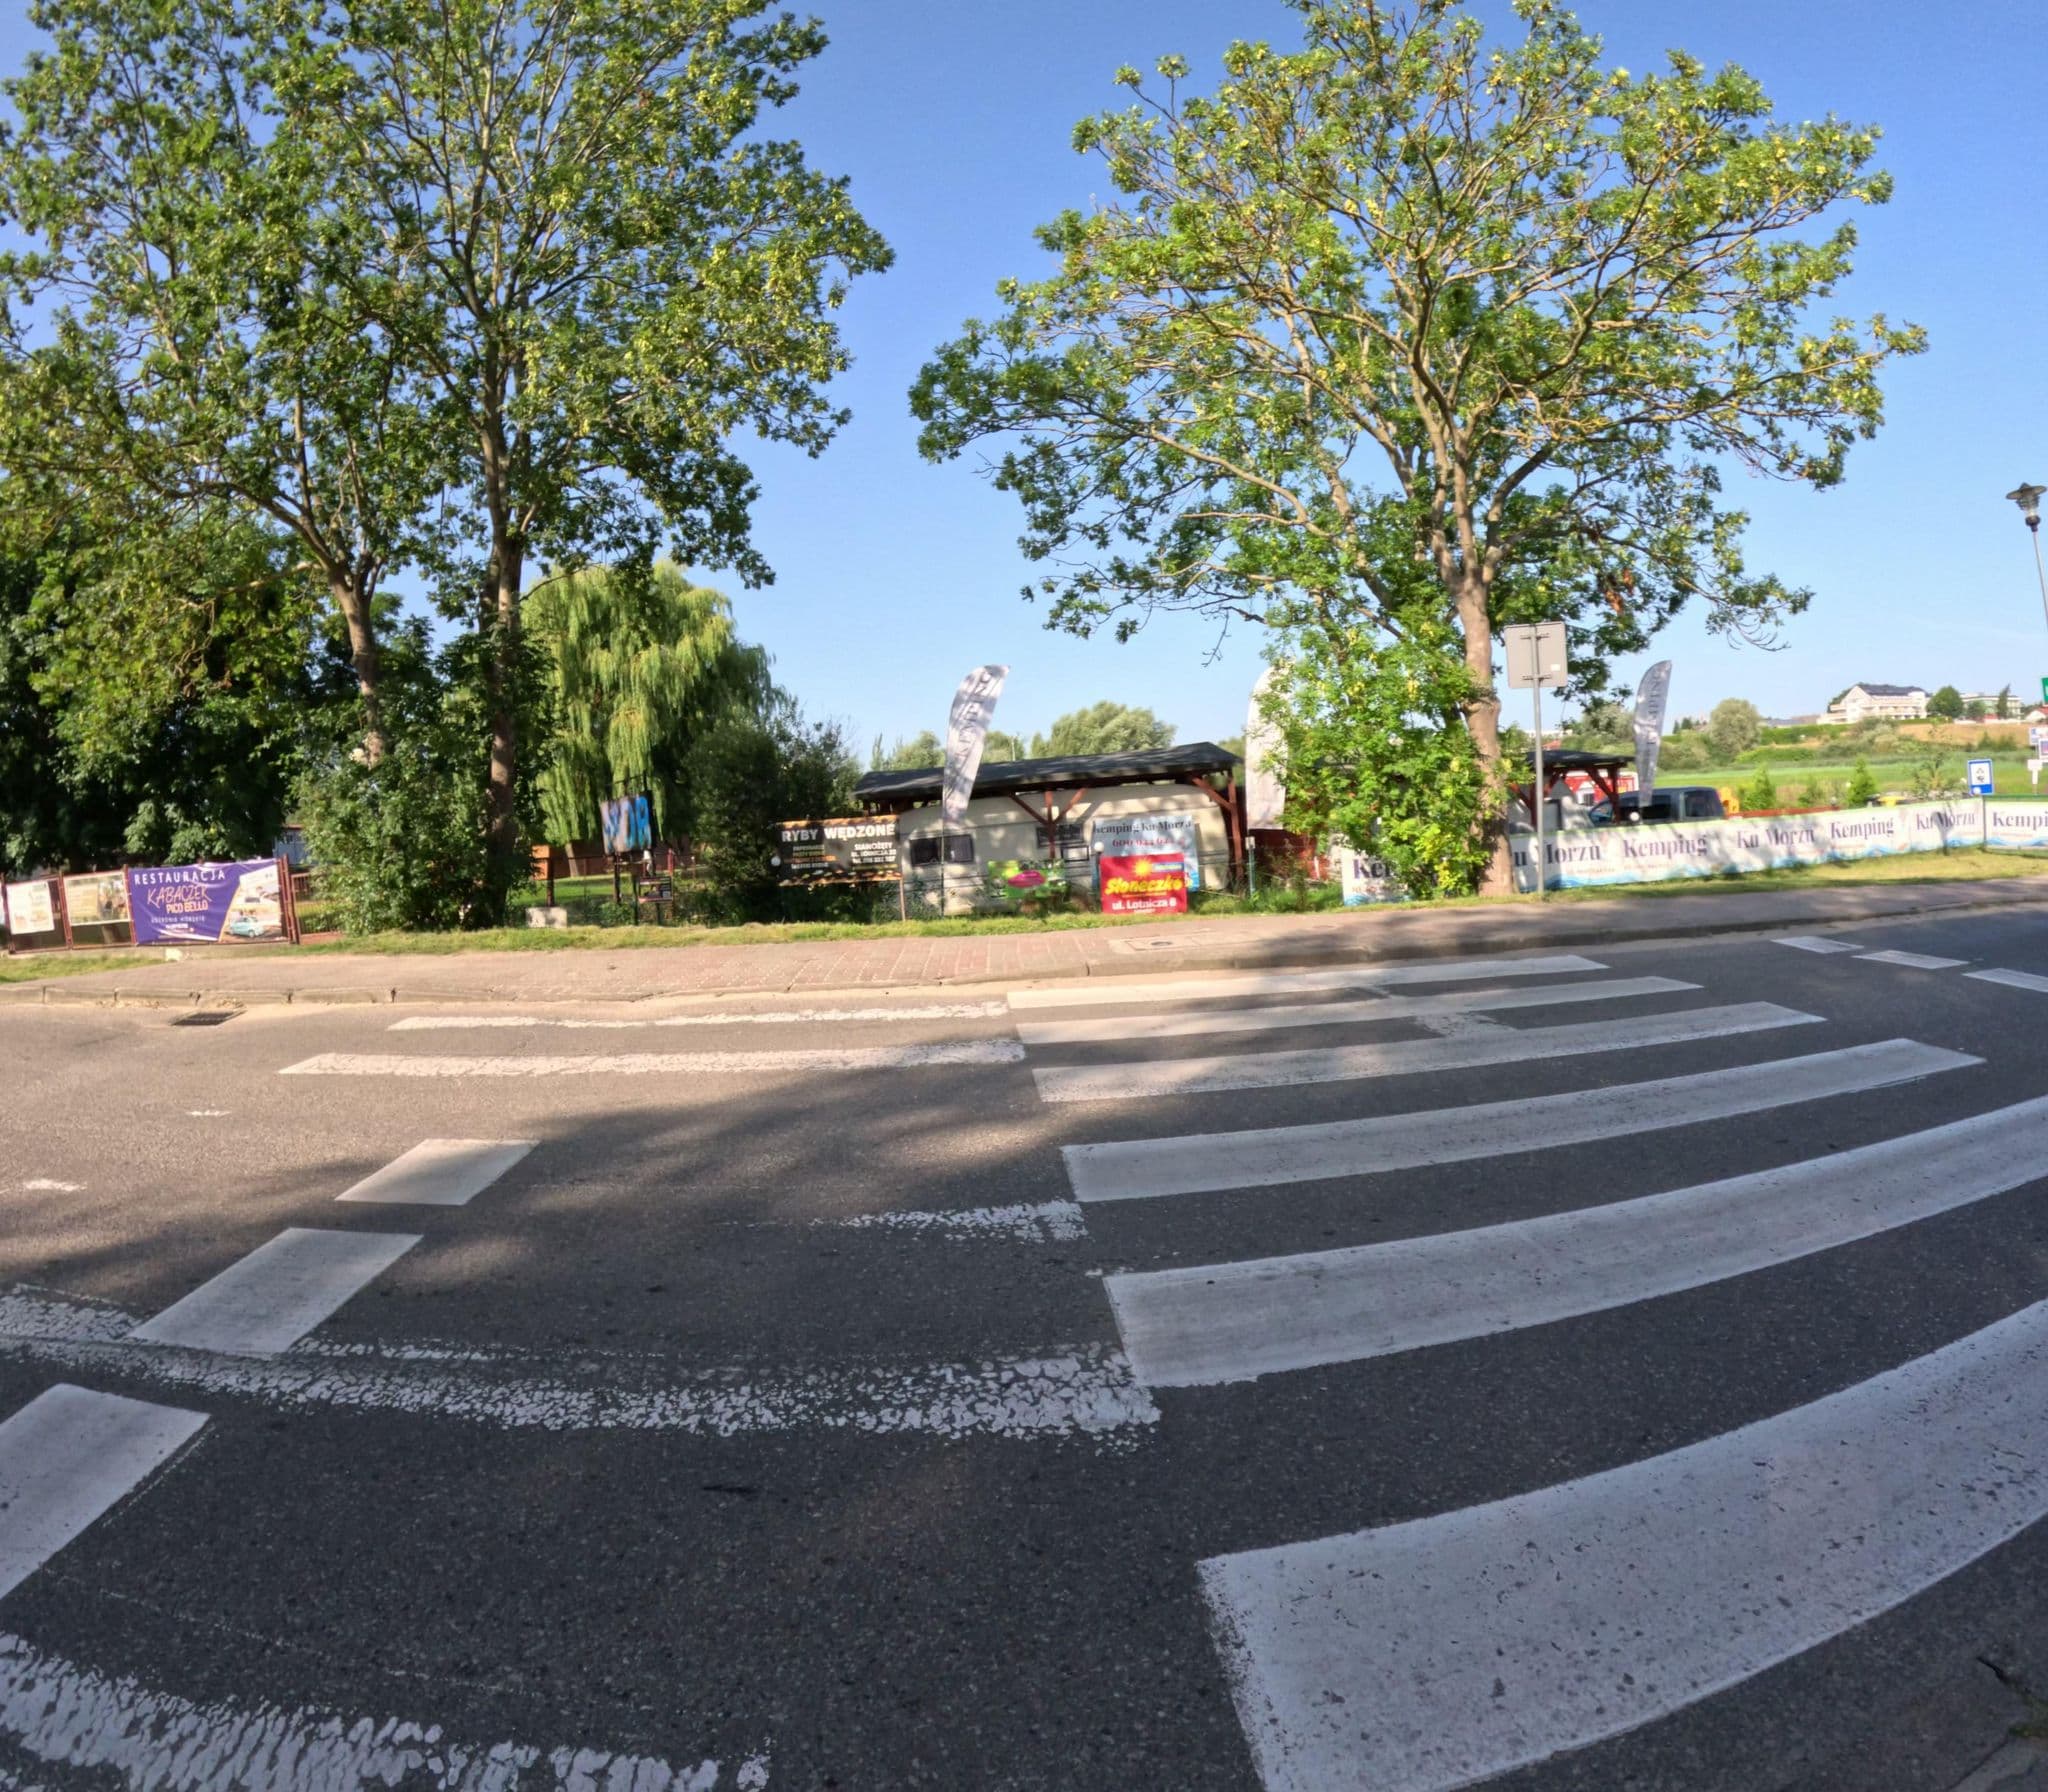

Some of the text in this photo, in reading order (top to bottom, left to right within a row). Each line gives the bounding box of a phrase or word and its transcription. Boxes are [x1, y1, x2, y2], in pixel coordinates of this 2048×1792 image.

[781, 823, 896, 842] RYBY WĘDZONE
[1830, 816, 1894, 840] Kemping
[1622, 834, 1708, 860] Kemping
[134, 869, 226, 886] RESTAURACJA
